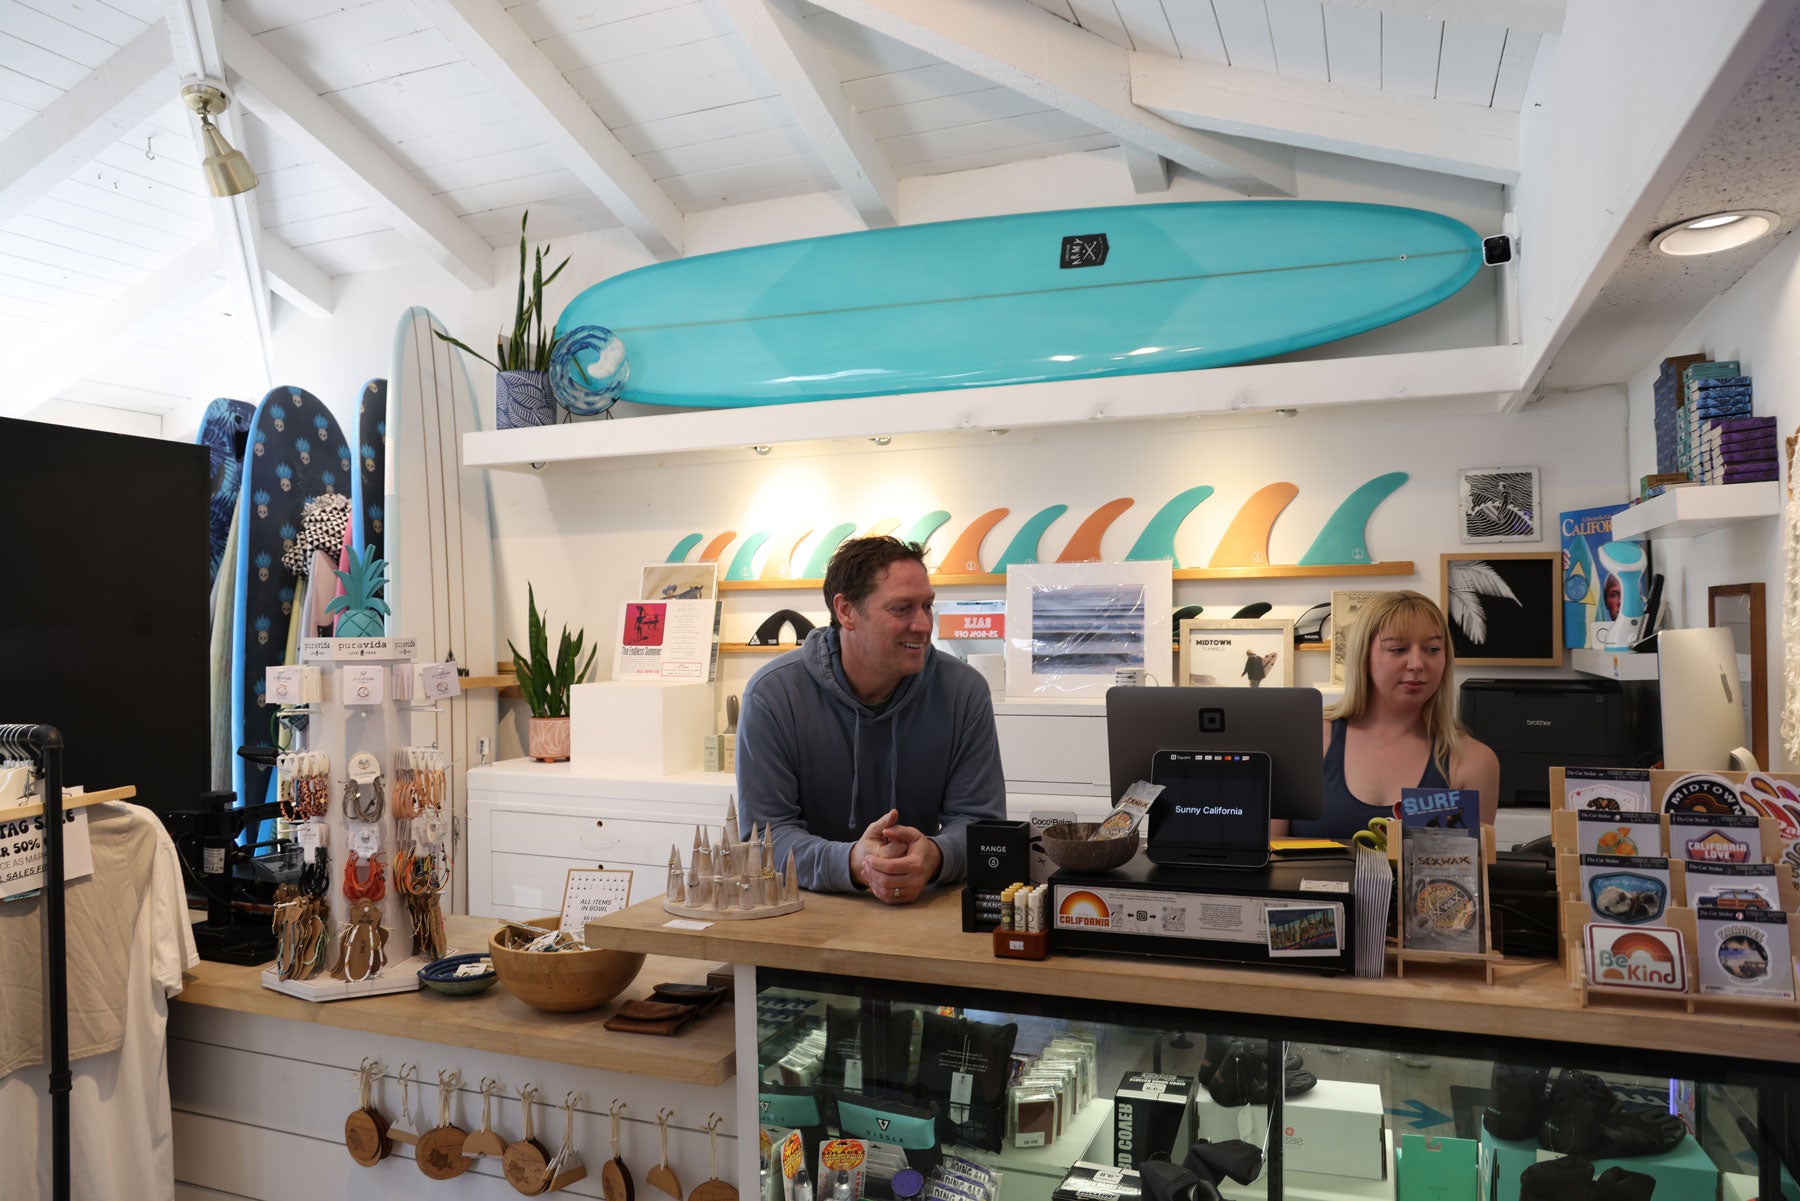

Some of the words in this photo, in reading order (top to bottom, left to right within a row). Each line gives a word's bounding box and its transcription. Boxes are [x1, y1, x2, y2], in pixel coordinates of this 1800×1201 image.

[1070, 238, 1083, 265] ARMY
[1562, 518, 1613, 537] CALIFOR
[338, 640, 387, 651] puravida
[629, 646, 645, 656] Endless
[645, 647, 662, 656] Summer
[1402, 790, 1460, 814] SURF
[1670, 783, 1743, 815] MIDTOWN
[1175, 805, 1201, 816] Sunny
[1203, 806, 1243, 816] California
[0, 819, 29, 839] TAG
[34, 809, 75, 831] SE
[13, 838, 41, 854] 50%
[980, 845, 1007, 853] RANGE
[1687, 841, 1747, 852] CALIFORNIA
[13, 857, 24, 866] AS
[26, 852, 48, 863] MAR
[1417, 856, 1473, 866] SEXWAX
[1704, 850, 1730, 860] LOVE
[6, 867, 35, 881] SALES
[1059, 915, 1110, 928] CALIFORNIA
[1718, 925, 1765, 944] CARMEL
[1600, 950, 1629, 968] Be
[1627, 963, 1677, 985] Kind
[954, 1160, 972, 1176] DING
[944, 1175, 966, 1190] DING
